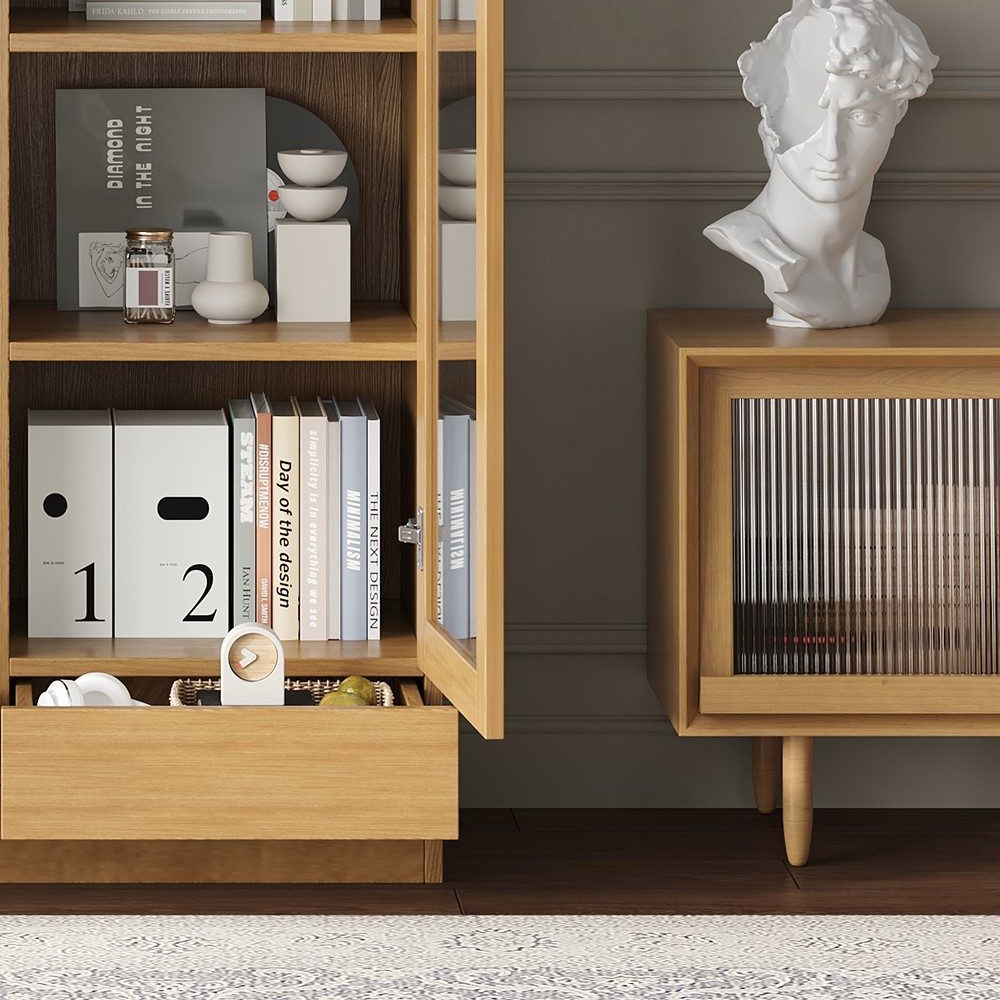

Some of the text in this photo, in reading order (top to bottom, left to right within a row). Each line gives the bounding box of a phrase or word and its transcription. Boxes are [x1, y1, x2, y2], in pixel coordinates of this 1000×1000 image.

[106, 119, 124, 189] DIAMOND
[135, 162, 152, 189] THE
[240, 431, 254, 524] STEAM
[258, 443, 269, 530] #DISRUPTMENOW
[276, 459, 293, 609] Day of the design
[307, 430, 320, 628] simplicity is in everything we see
[346, 488, 361, 573] MINIMALISM
[370, 491, 379, 630] THE NEXT DESIGN
[74, 561, 106, 622] 1
[182, 563, 218, 622] 2
[242, 566, 251, 620] IAN HUNT
[260, 578, 268, 595] DAVID
